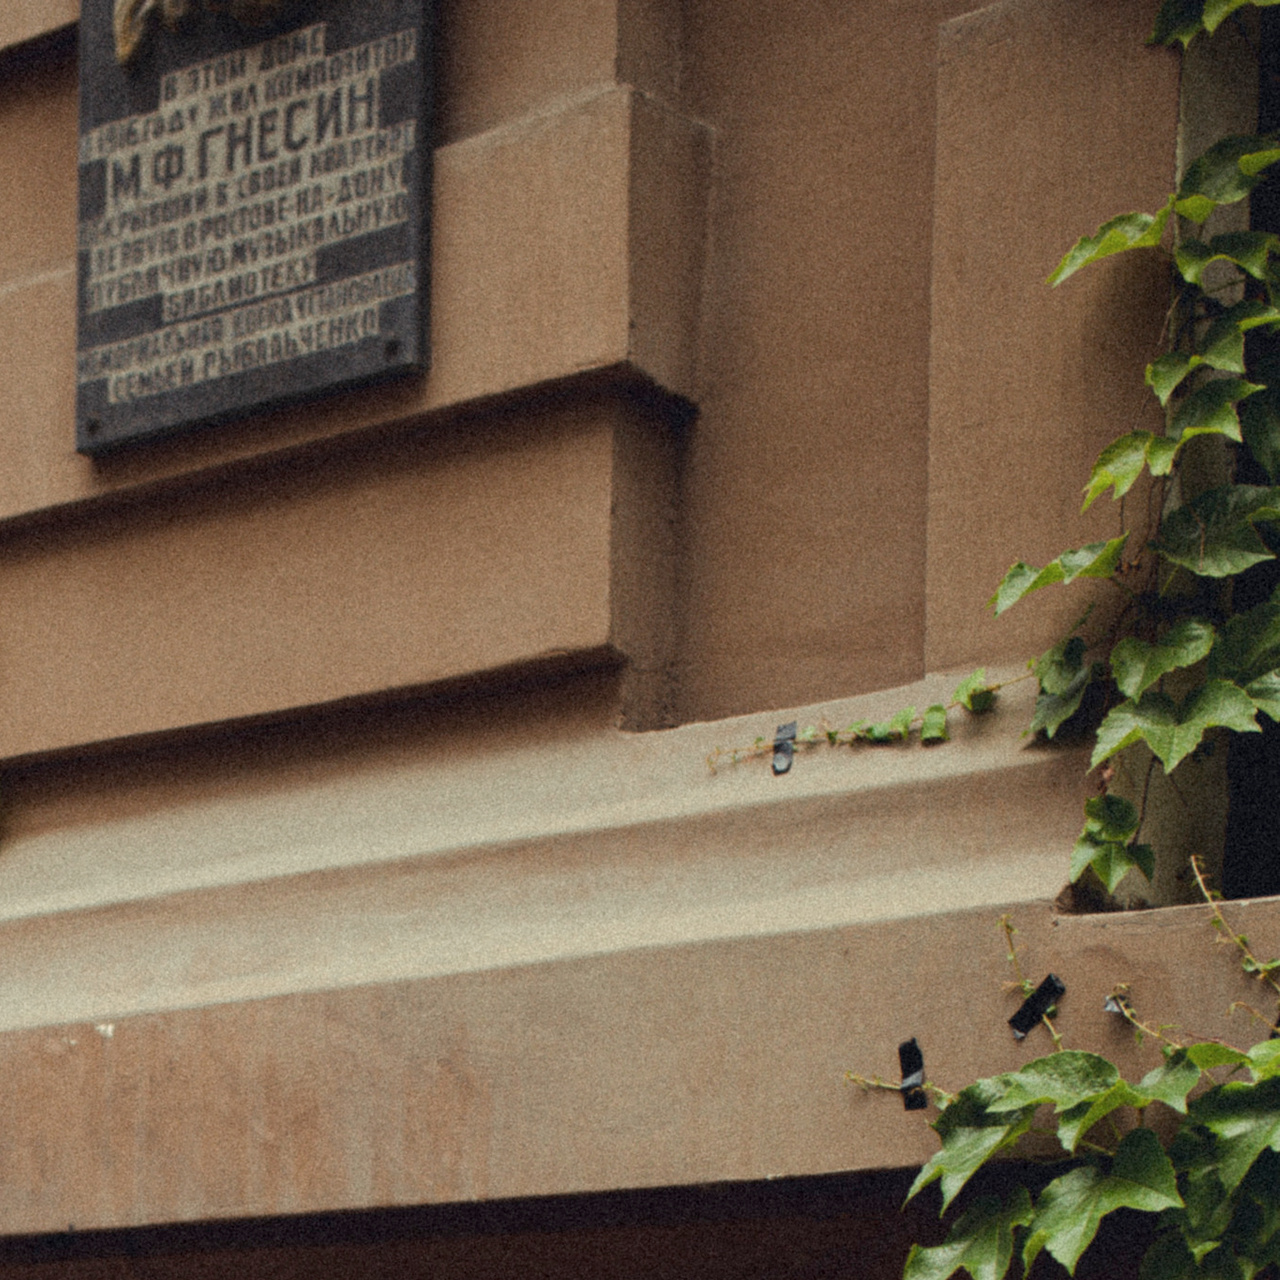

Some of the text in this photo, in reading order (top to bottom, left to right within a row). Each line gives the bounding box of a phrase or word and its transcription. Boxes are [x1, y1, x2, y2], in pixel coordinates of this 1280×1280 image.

[165, 26, 322, 101] В ЭТОМ ДОМЕ
[210, 82, 257, 119] ЖИЛ
[264, 31, 414, 103] КОМПОЗИТОР
[239, 157, 301, 200] СВОЕЙ
[310, 122, 414, 178] КВАРТИРЕ
[168, 255, 312, 319] БИБЛИОТЕКУ
